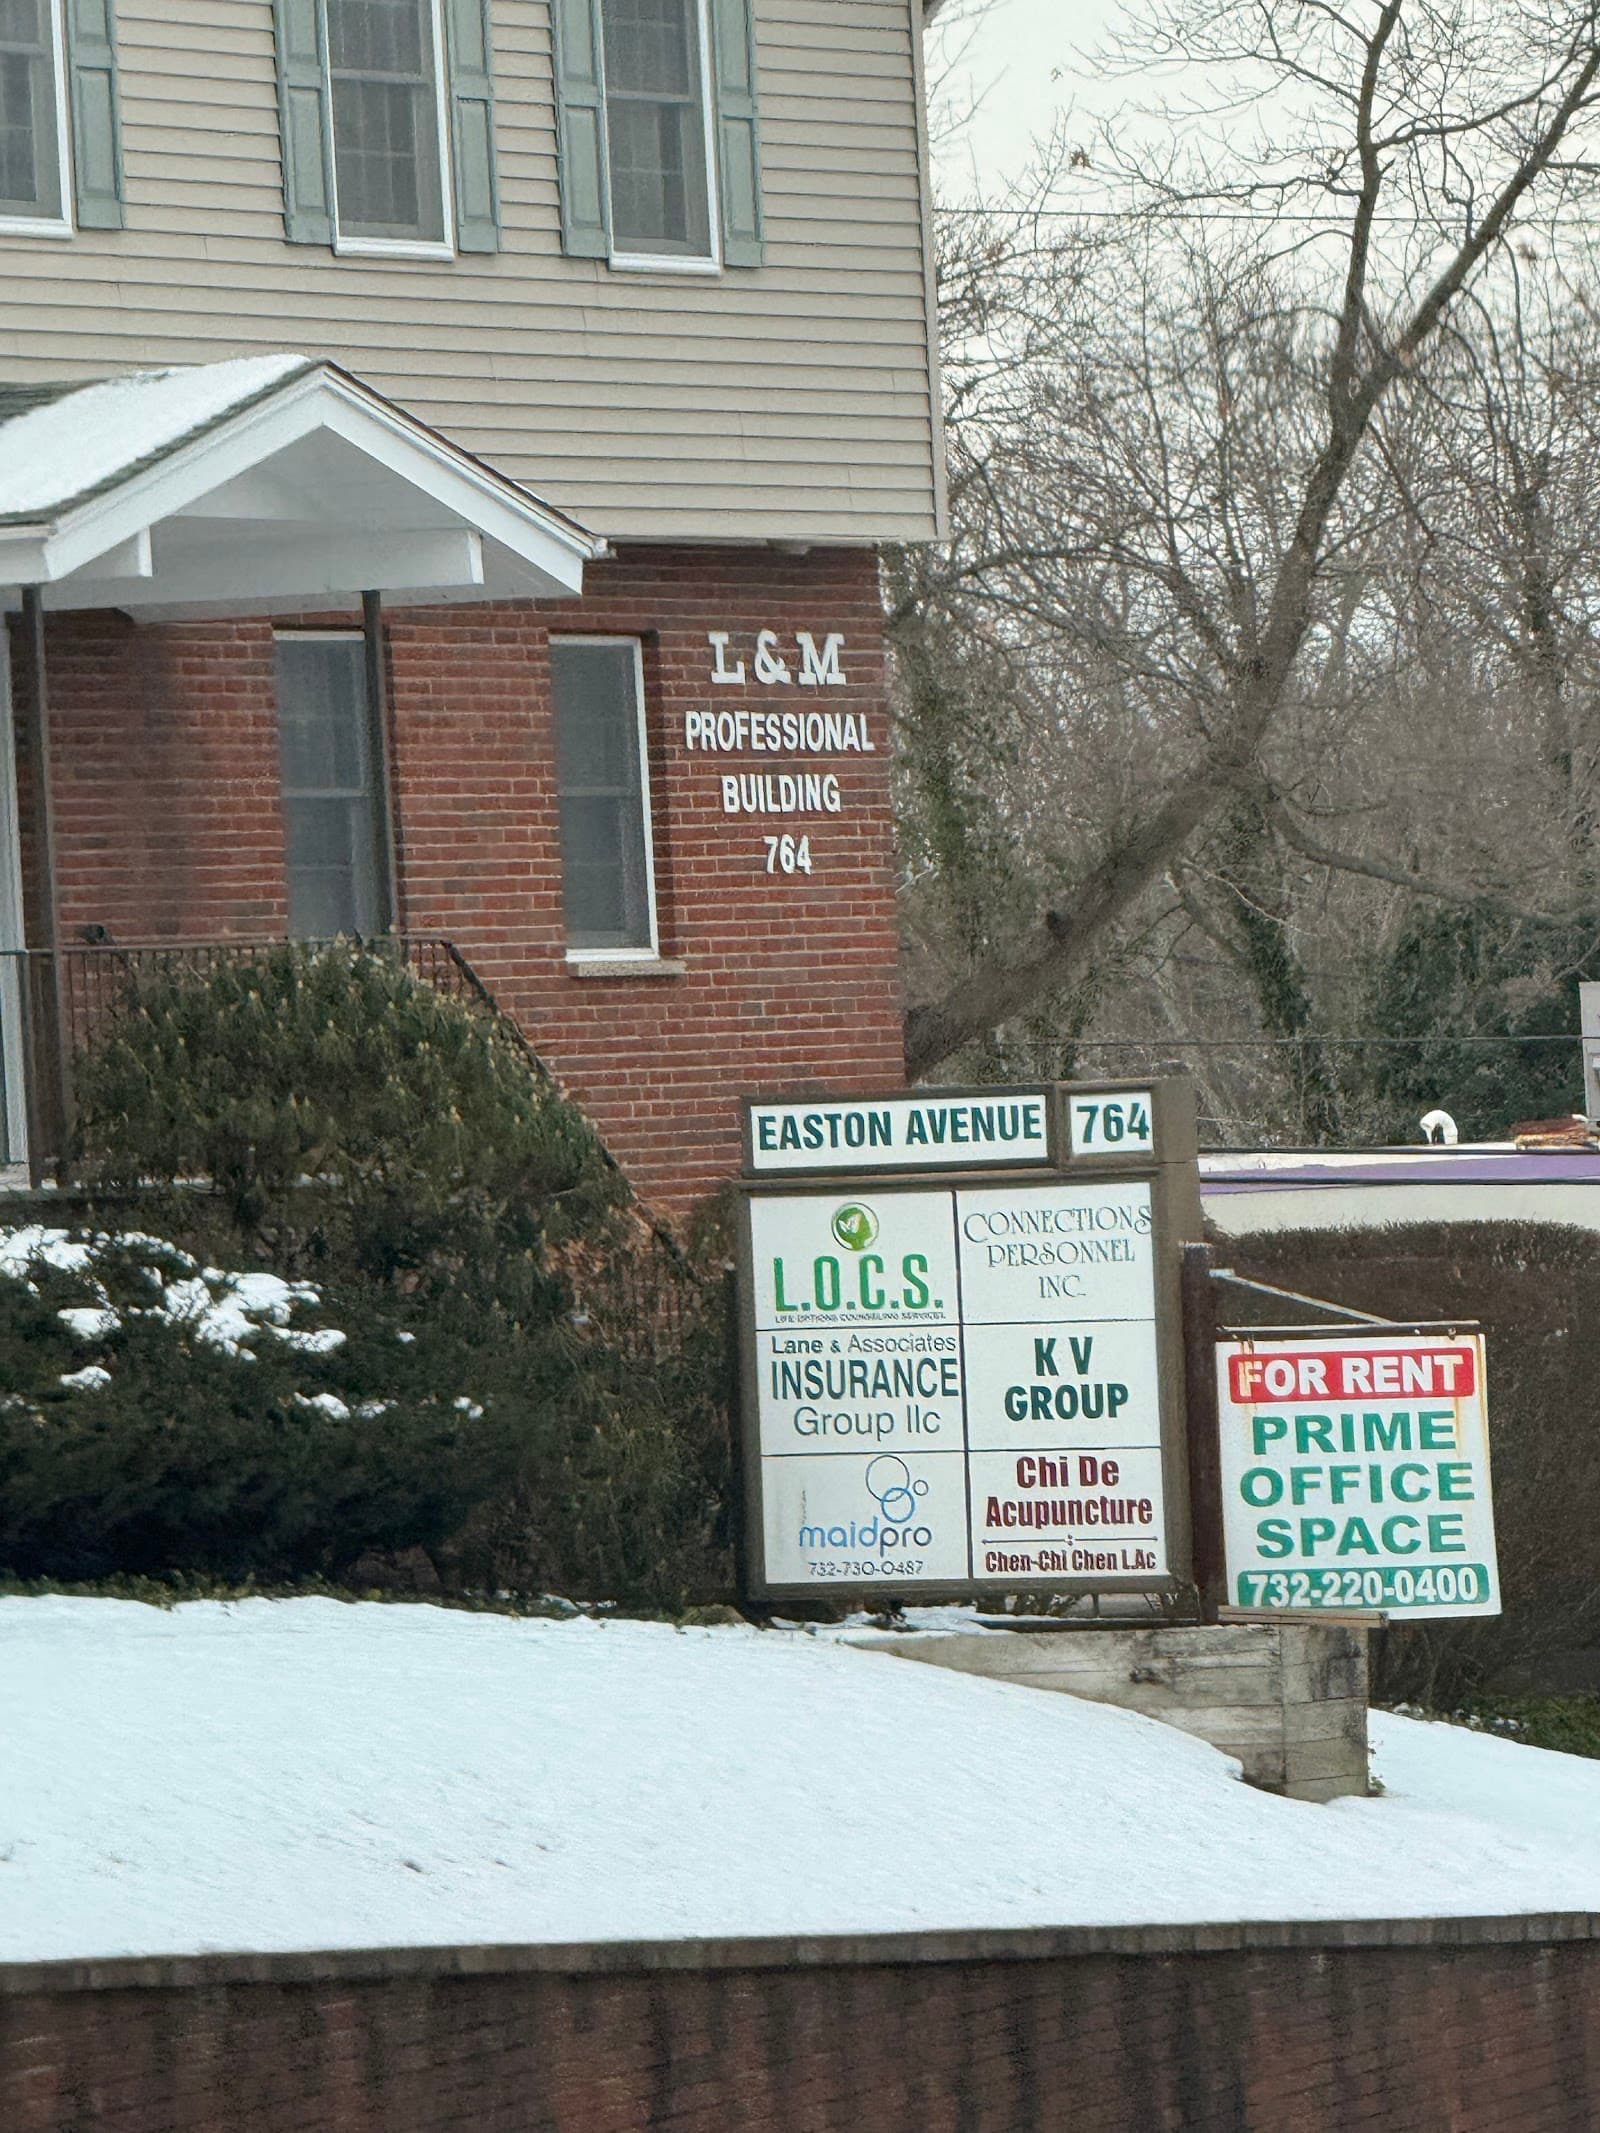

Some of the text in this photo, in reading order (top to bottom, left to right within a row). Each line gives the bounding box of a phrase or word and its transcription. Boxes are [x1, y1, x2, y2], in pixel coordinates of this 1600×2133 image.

[685, 710, 875, 751] PROFESSIONAL
[721, 774, 841, 813] BUILDING
[763, 833, 812, 875] 764
[757, 1103, 1042, 1151] EASTON AVENUE
[1076, 1102, 1150, 1144] 764
[963, 1205, 1152, 1244] CONNECTIONS
[986, 1239, 1136, 1268] PERSONNEL
[773, 1253, 944, 1312] L.O.C.S.
[771, 1332, 957, 1354] Lane & Associates
[771, 1357, 960, 1401] INSURANCE
[1237, 1355, 1464, 1397] FOR RENT
[793, 1404, 941, 1442] Group llc
[1004, 1383, 1129, 1422] GROUP
[1252, 1411, 1457, 1455] PRIME
[1016, 1456, 1120, 1489] Chi De
[1239, 1462, 1475, 1507] OFFICE
[985, 1496, 1153, 1530] Acupuncture
[799, 1515, 933, 1558] maidpro
[1255, 1513, 1467, 1558] SPACE
[808, 1560, 924, 1577] 732-730-0487
[1071, 1549, 1118, 1571] Chen
[1247, 1566, 1479, 1608] 732-220-0400
